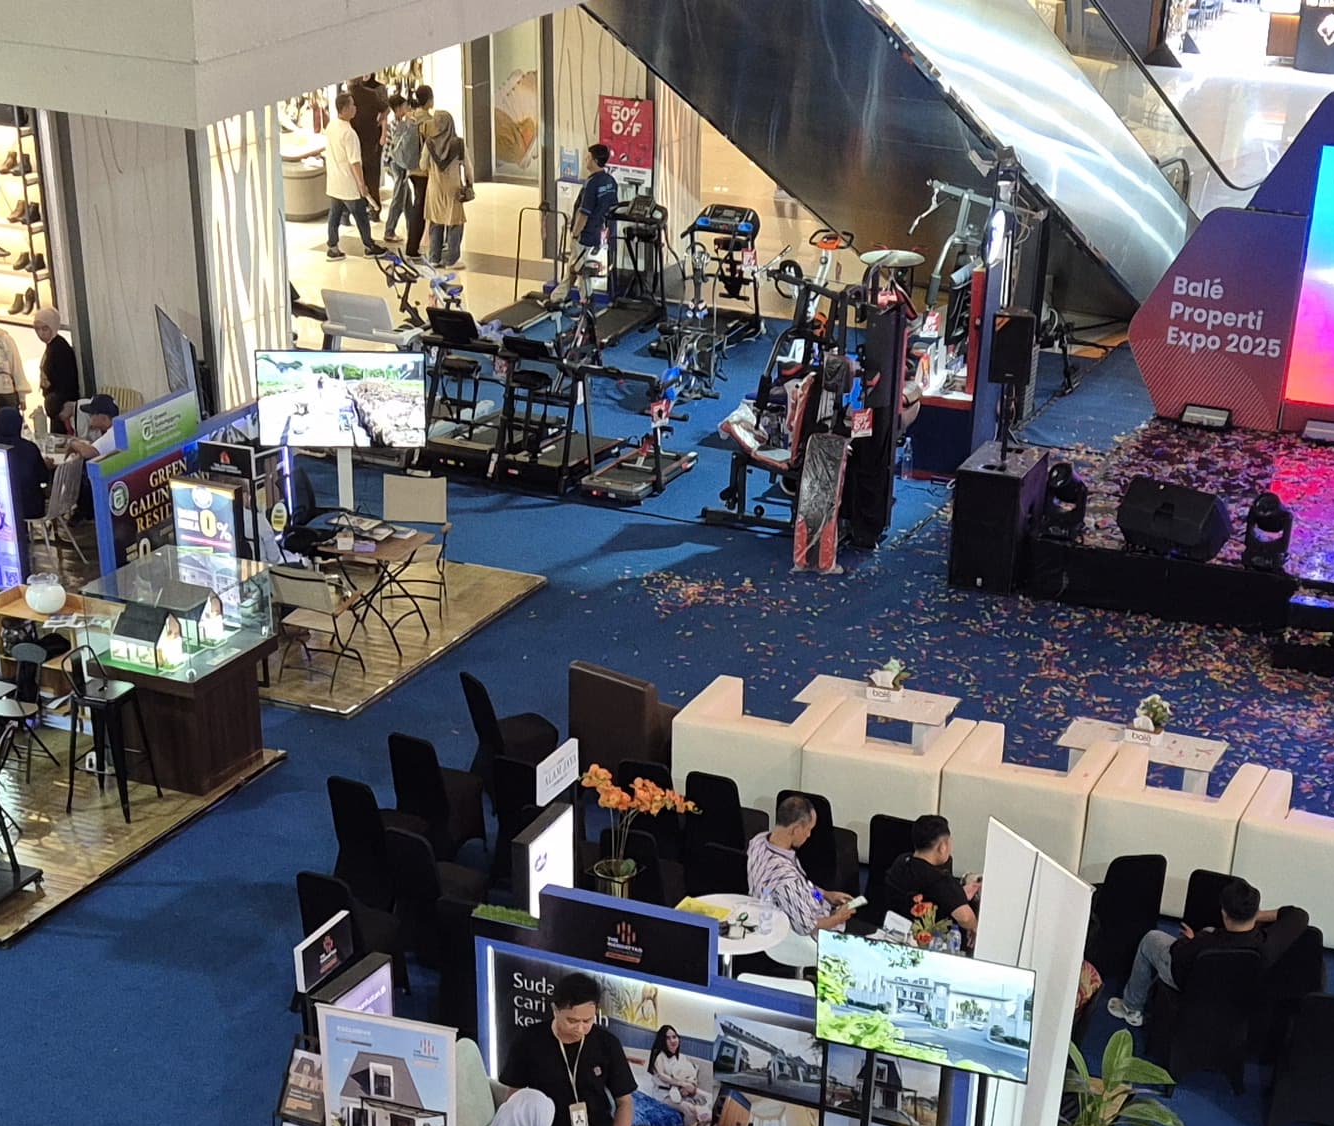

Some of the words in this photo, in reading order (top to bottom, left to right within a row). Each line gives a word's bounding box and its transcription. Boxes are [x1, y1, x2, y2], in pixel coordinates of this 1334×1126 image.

[1173, 275, 1224, 301] Balé
[1169, 300, 1264, 332] Properti
[1166, 326, 1223, 357] Expo
[1225, 333, 1282, 358] 2025
[149, 457, 188, 488] GREEN
[513, 972, 555, 996] Suda
[514, 995, 546, 1013] cari
